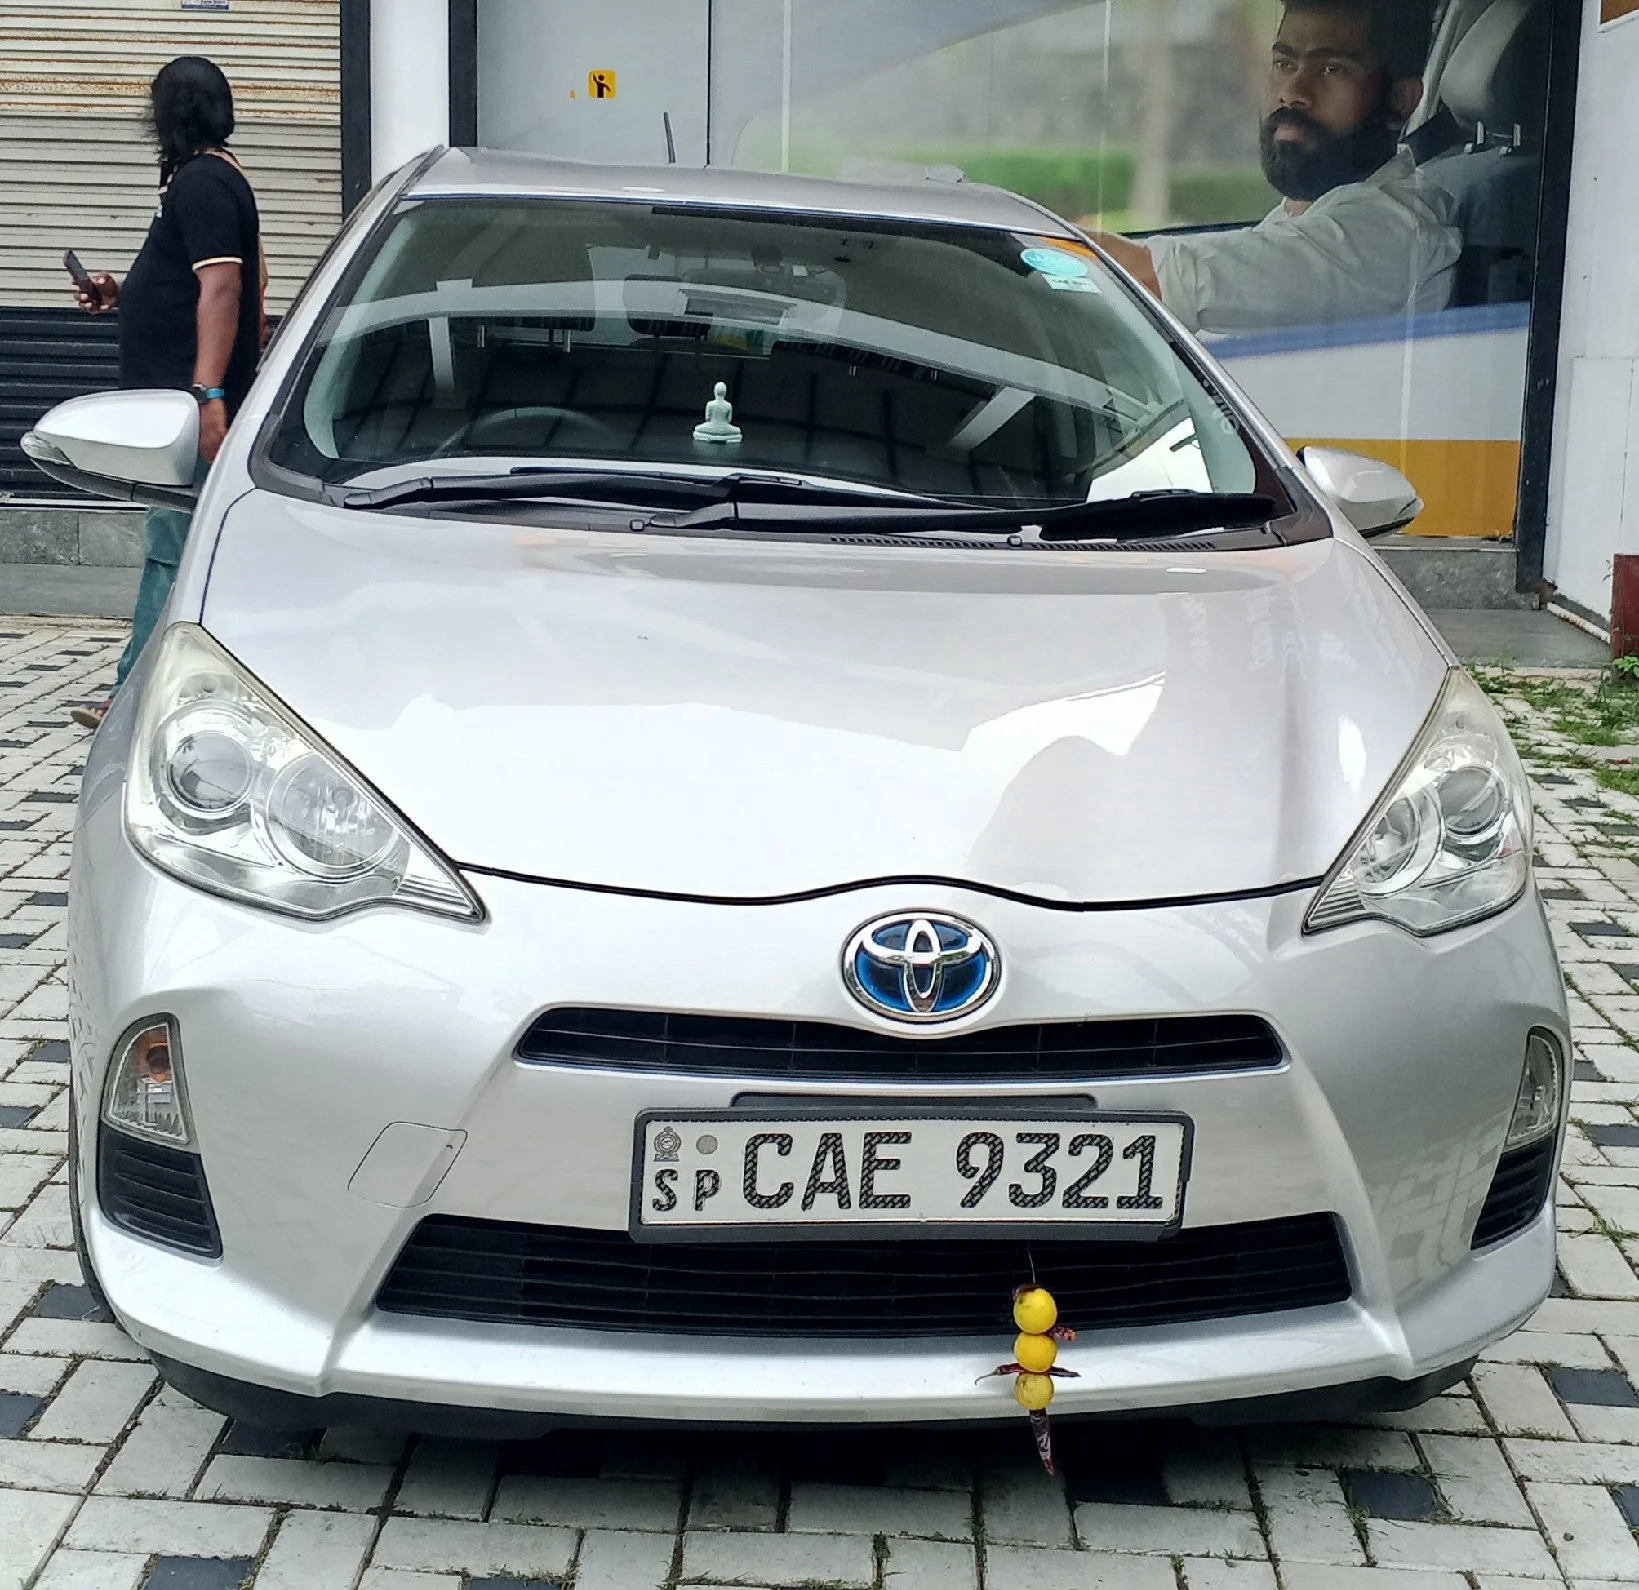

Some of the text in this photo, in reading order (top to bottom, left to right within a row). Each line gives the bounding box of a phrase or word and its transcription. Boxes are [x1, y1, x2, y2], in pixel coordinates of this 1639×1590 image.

[651, 1132, 1164, 1212] SP CAE 9321
